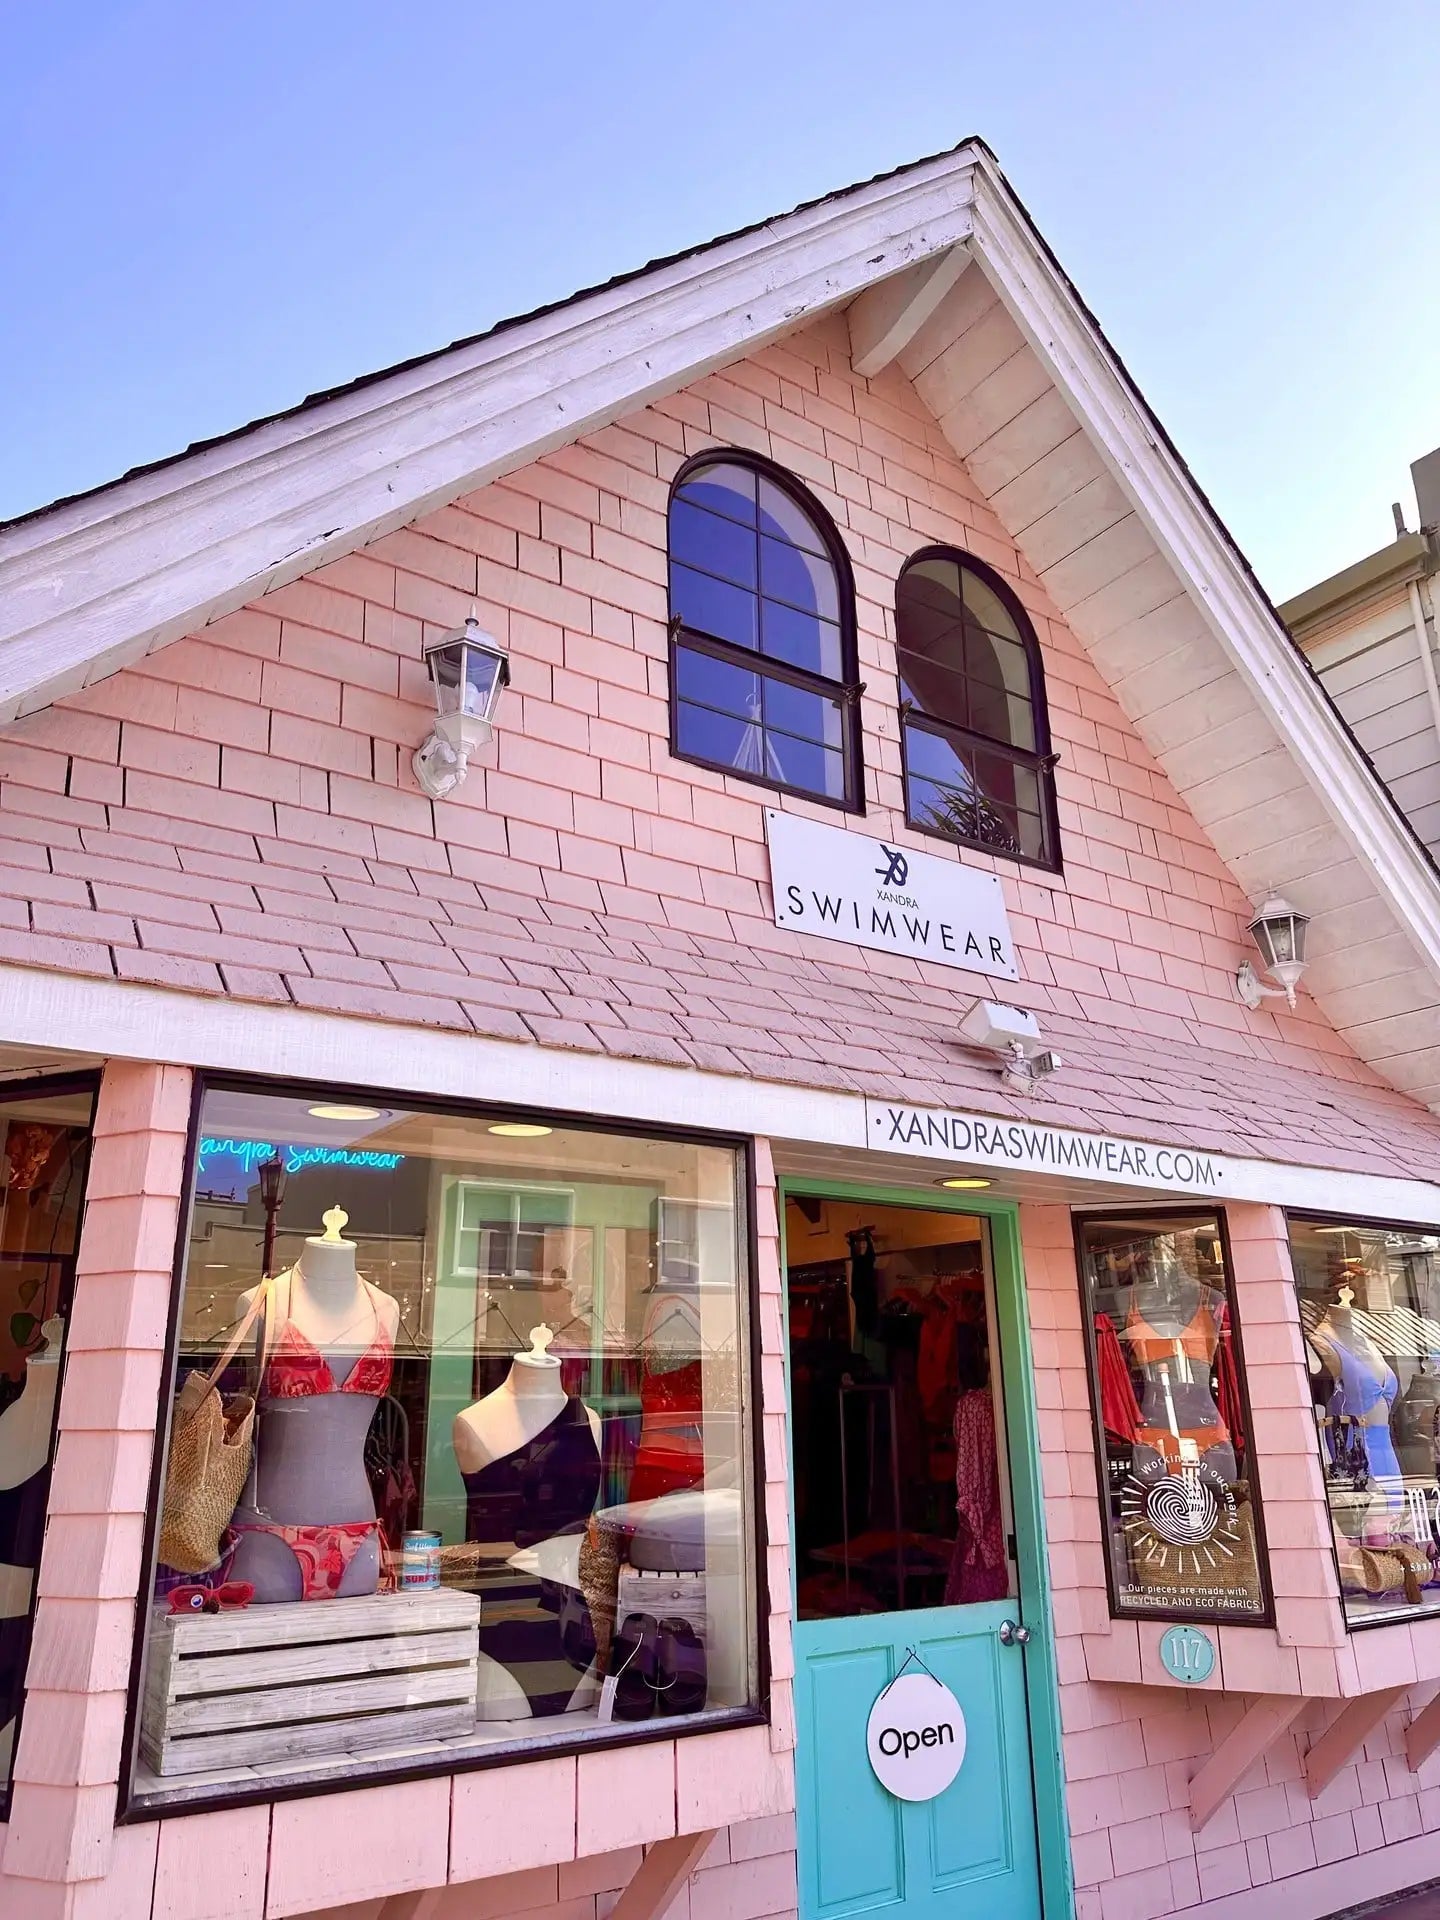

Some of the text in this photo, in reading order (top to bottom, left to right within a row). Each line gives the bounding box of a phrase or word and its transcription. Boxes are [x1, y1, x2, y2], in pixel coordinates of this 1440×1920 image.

[877, 889, 919, 909] XANDRA
[787, 885, 1006, 964] SWIMWEAR
[1141, 1453, 1182, 1475] Workin
[1211, 1470, 1229, 1491] our
[1225, 1492, 1239, 1525] mark
[405, 1574, 437, 1584] SURF'S
[1128, 1583, 1248, 1596] Our pieces are made with
[1120, 1595, 1259, 1609] RECYCLED AND ECO FABRICS
[1170, 1637, 1202, 1669] 117
[878, 1722, 955, 1759] Open
